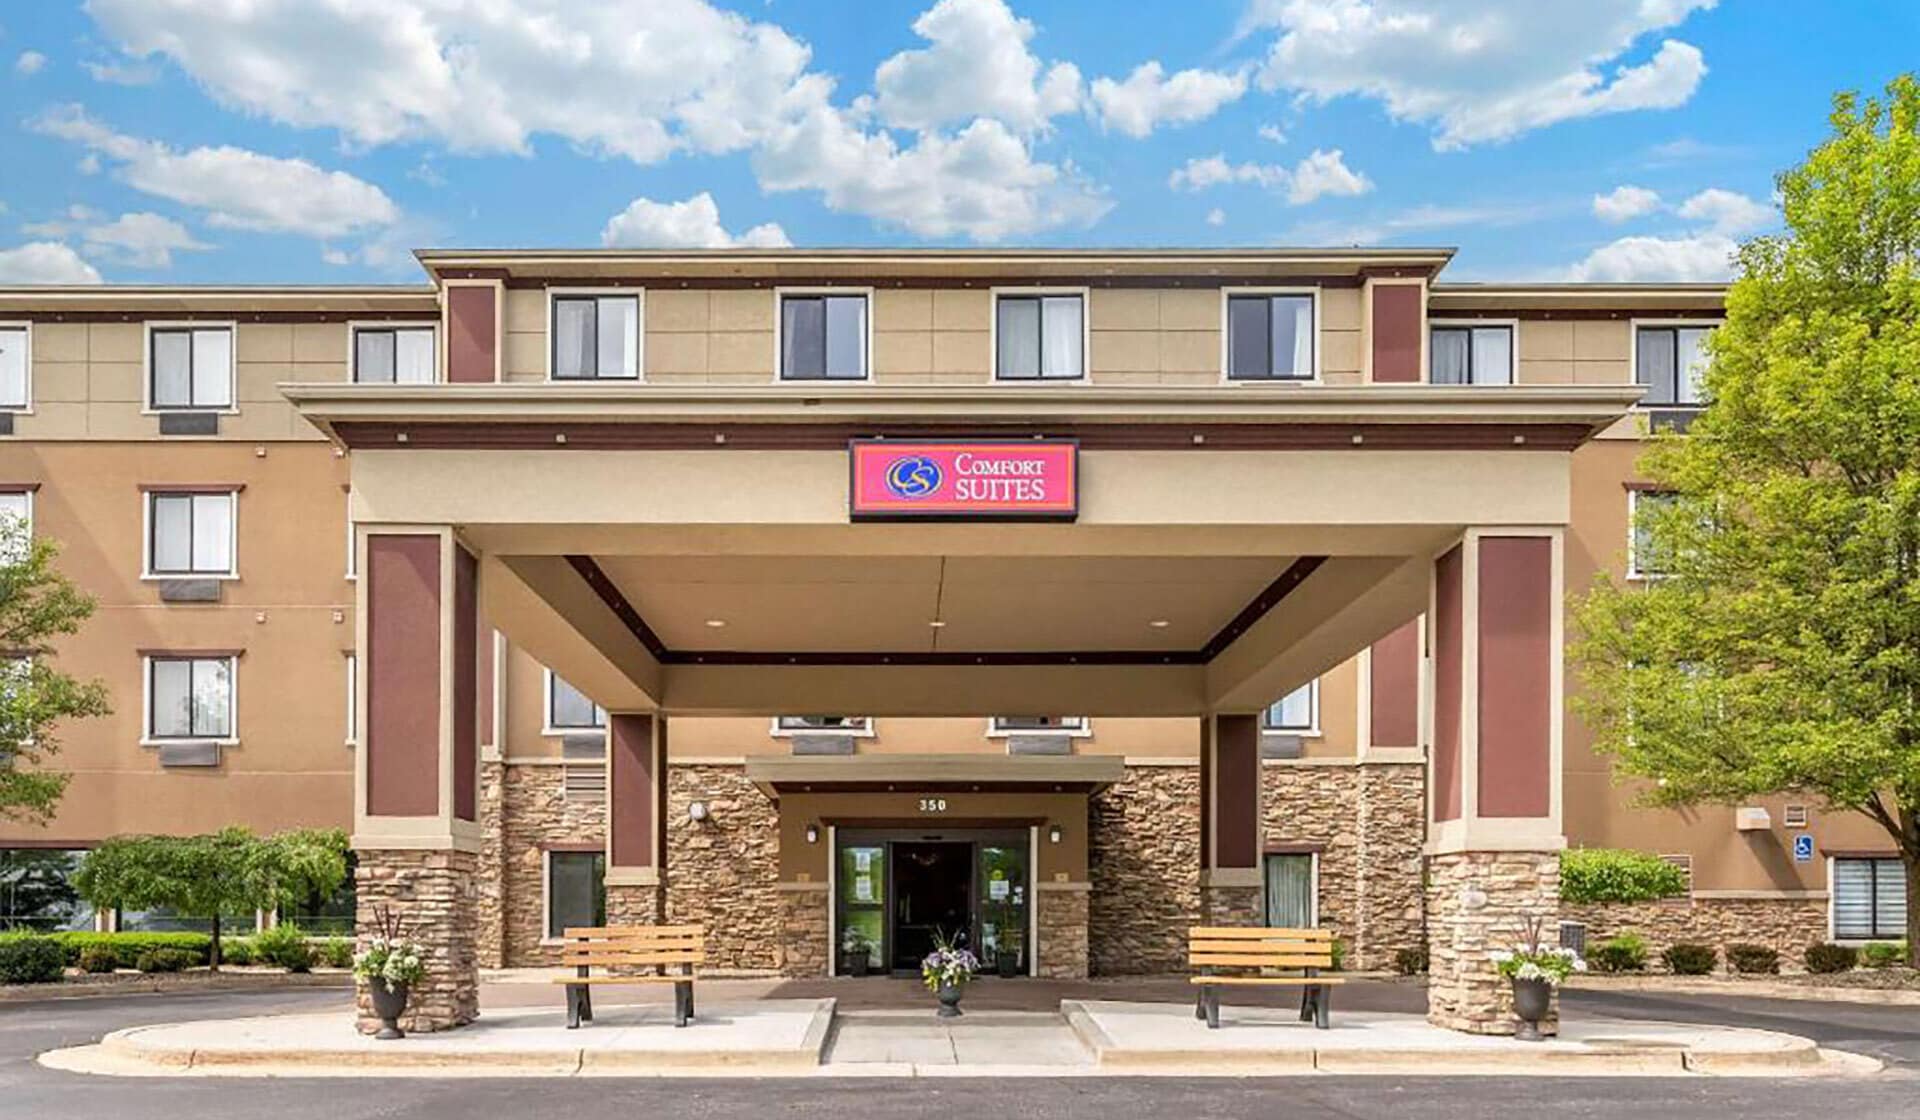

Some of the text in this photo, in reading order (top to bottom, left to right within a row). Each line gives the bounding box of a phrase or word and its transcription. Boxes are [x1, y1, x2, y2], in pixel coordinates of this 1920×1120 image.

[955, 453, 1045, 475] COMFORT
[955, 479, 1045, 500] SUITES
[919, 799, 946, 811] 350
